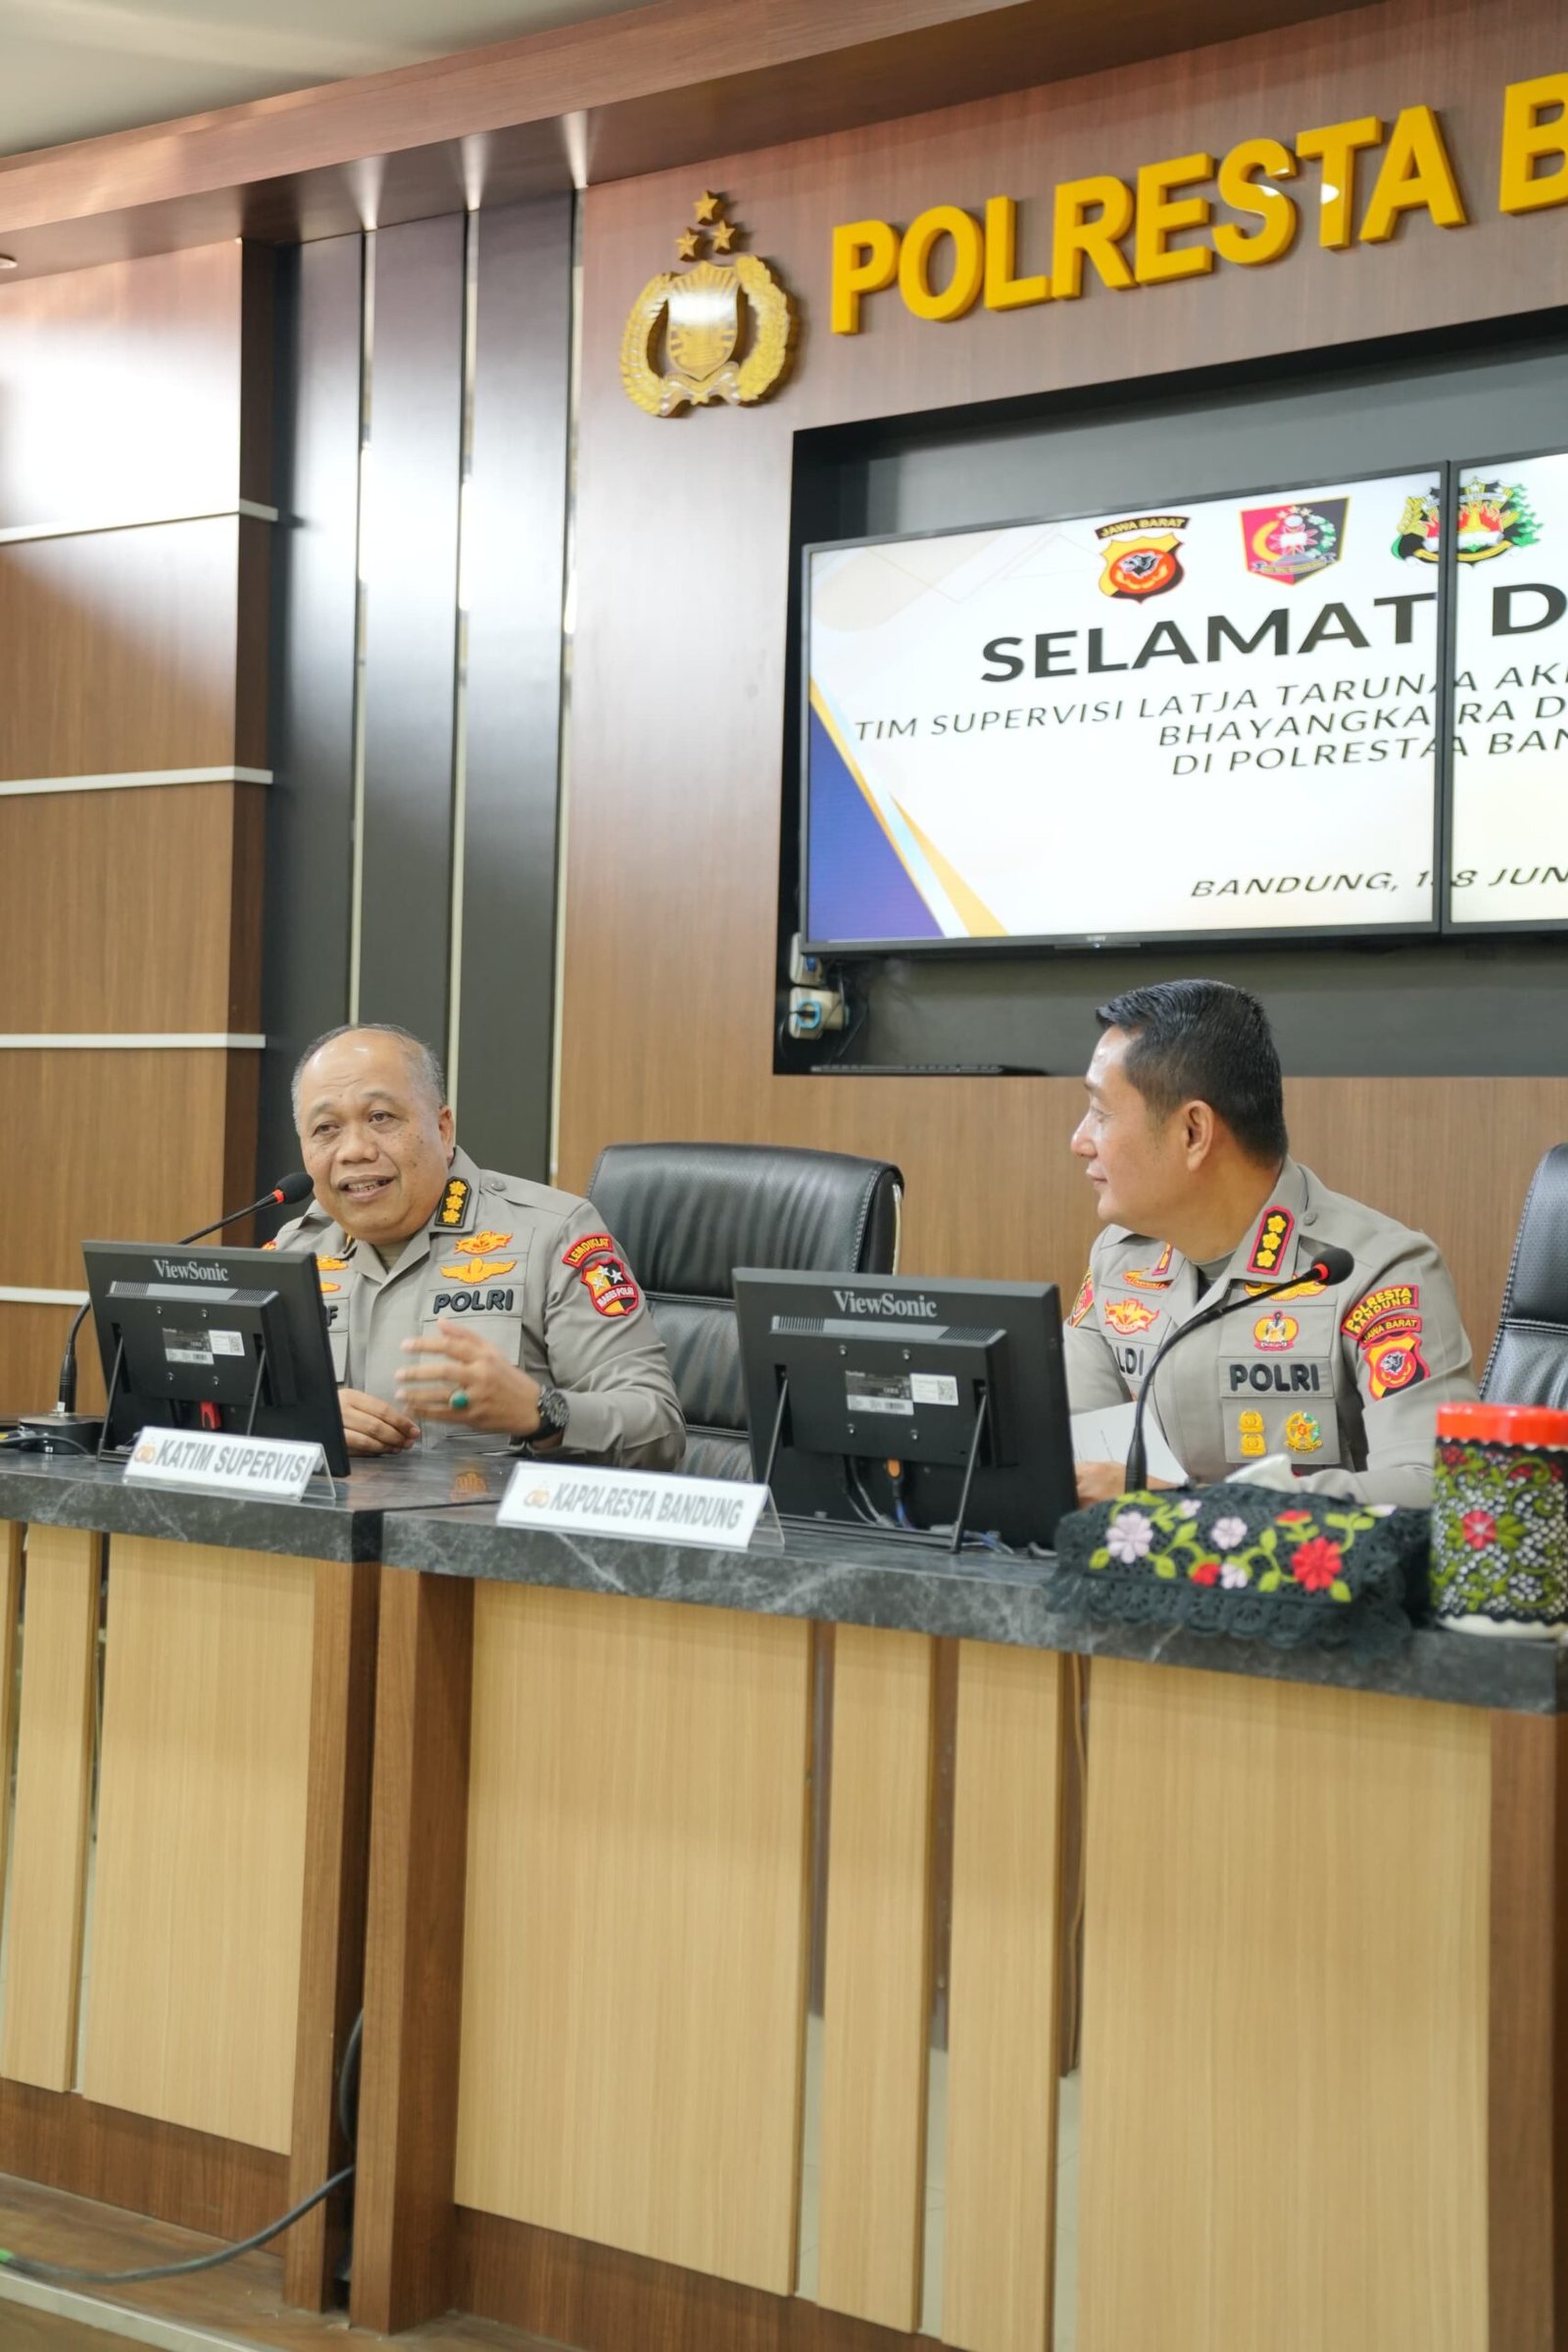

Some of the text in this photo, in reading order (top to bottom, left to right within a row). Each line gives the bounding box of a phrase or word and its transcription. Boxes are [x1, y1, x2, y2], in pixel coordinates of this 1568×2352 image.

[831, 72, 1568, 335] POLRESTA B
[1101, 517, 1186, 538] JAWA BARAT
[981, 583, 1567, 683] SELAMAT D
[856, 662, 1568, 741] TIM SUPERVISI LATJA TARUNA AK
[1159, 696, 1566, 747] BHAYANGKARA D
[1172, 754, 1211, 776] DI
[1228, 736, 1468, 772] POLRESTA
[1191, 872, 1398, 898] BANDUNG,
[153, 1259, 229, 1281] ViewSonic
[433, 1289, 514, 1314] POLRI
[833, 1291, 937, 1318] ViewSonic
[1345, 1288, 1412, 1332] POLRESTA
[1363, 1319, 1417, 1344] JAWA BARAT
[1230, 1363, 1320, 1393] POLRI
[155, 1440, 315, 1483] KATIM SUPERVISI
[550, 1482, 744, 1530] KAPOLRESTA BANDUNG
